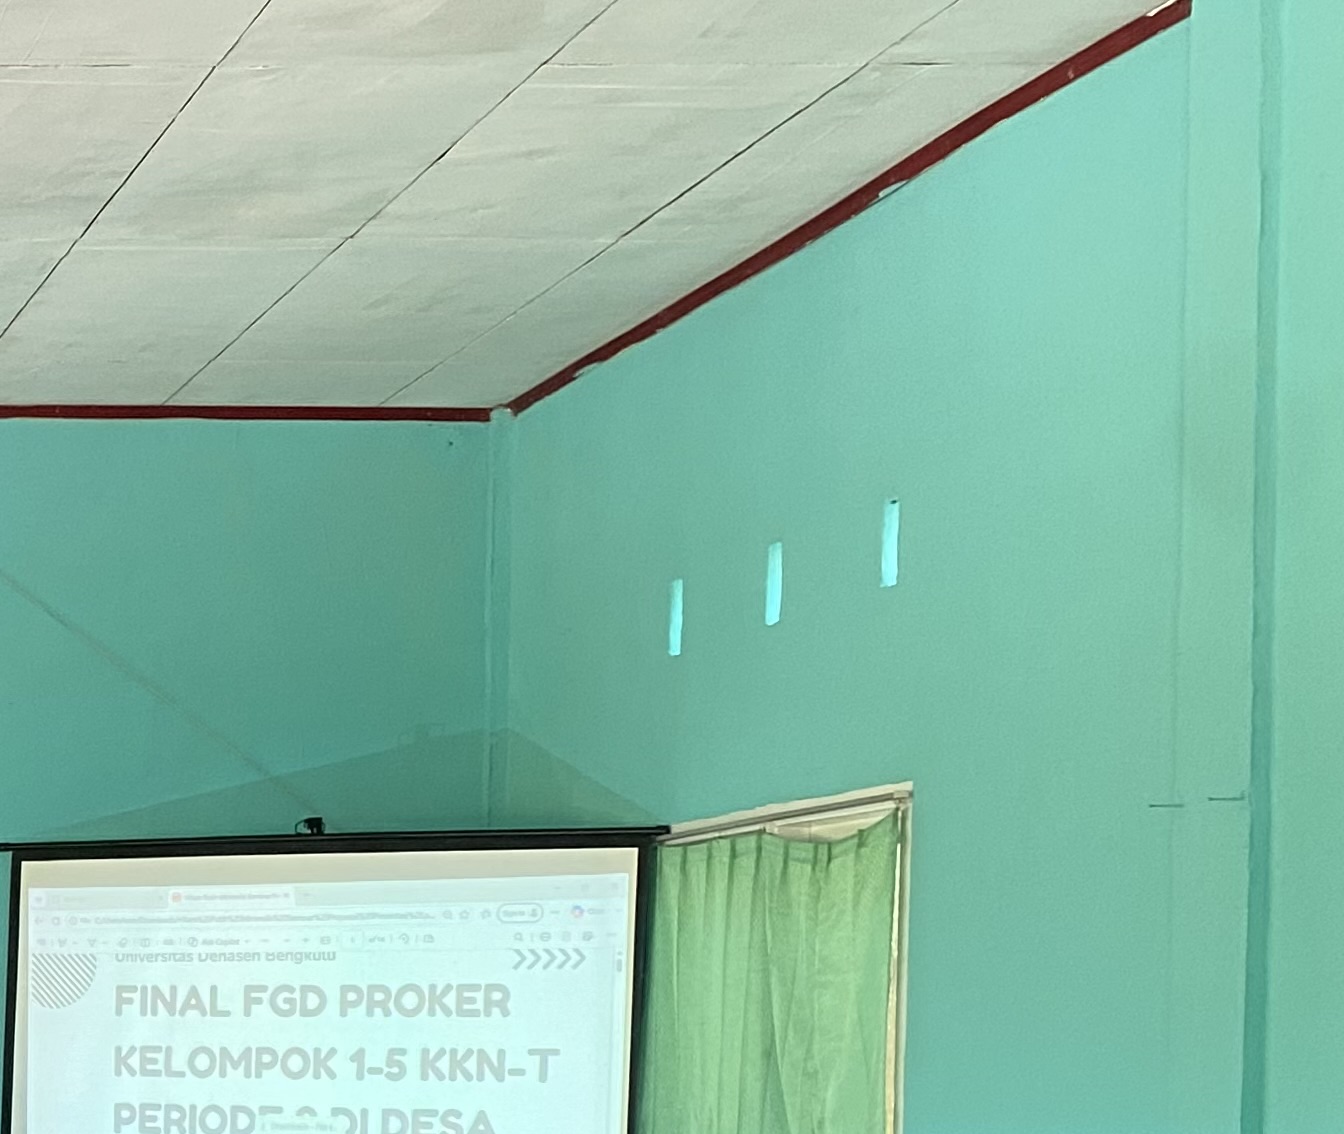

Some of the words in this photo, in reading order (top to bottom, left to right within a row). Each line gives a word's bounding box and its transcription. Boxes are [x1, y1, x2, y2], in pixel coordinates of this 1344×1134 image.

[115, 984, 231, 1018] FINAL
[243, 984, 327, 1018] FGD
[339, 983, 511, 1018] PROKER
[114, 1046, 338, 1080] KELOMPOK
[349, 1047, 408, 1082] 1-5
[421, 1047, 560, 1083] KKN-T
